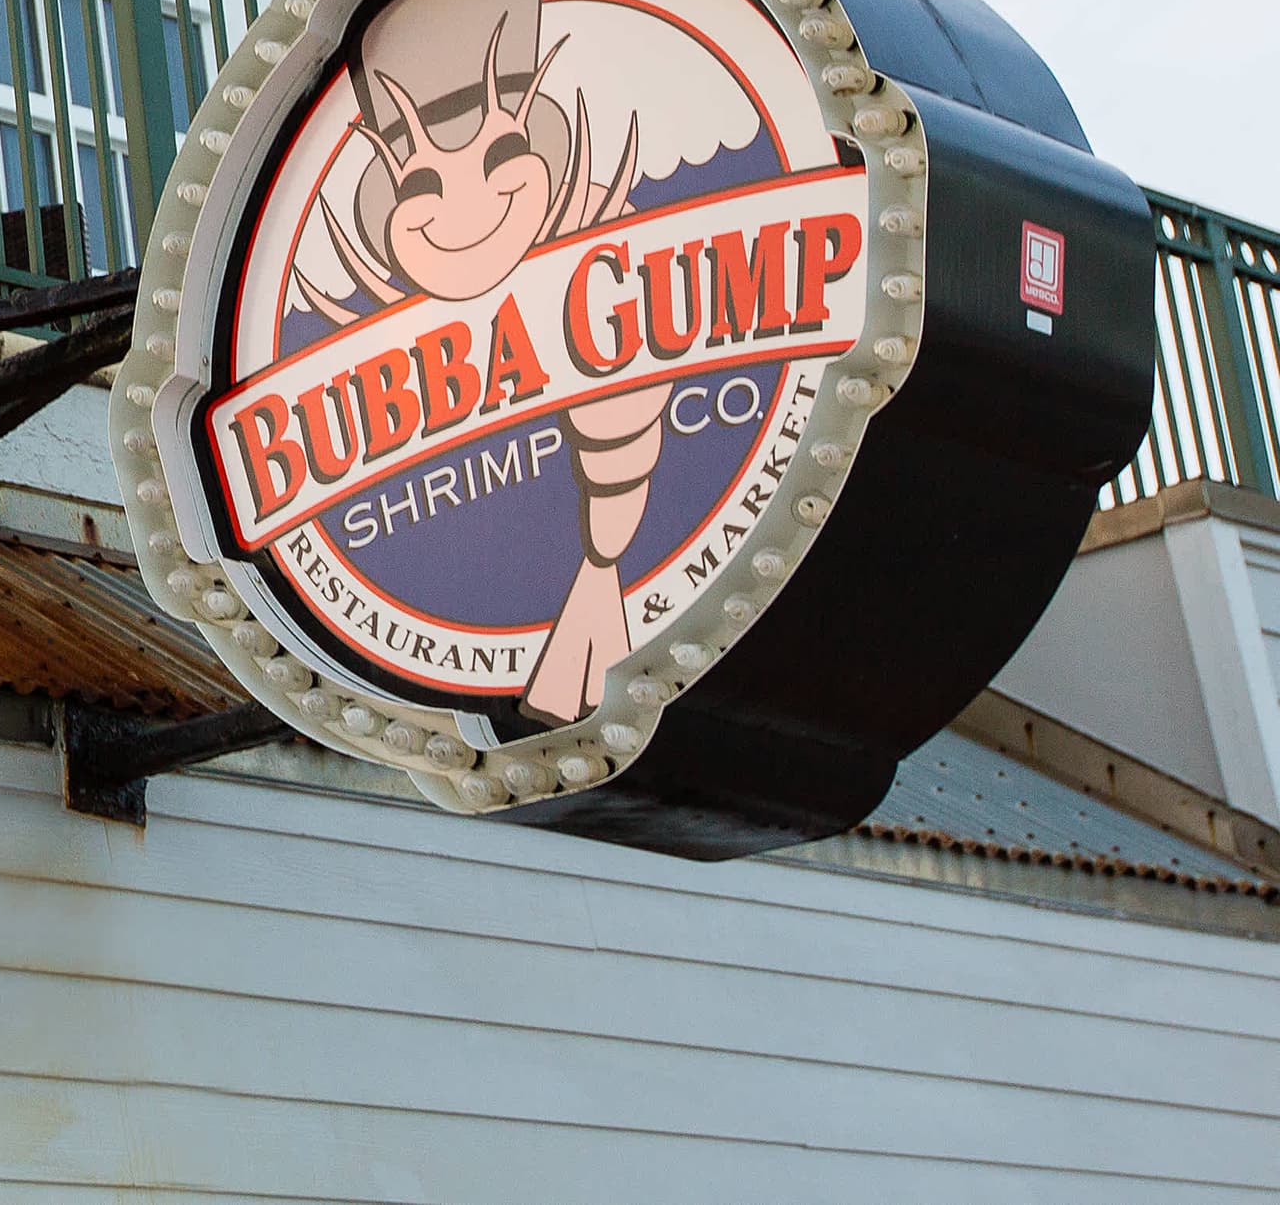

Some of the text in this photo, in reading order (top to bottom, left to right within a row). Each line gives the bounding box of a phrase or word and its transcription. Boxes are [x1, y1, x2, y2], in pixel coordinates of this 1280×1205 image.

[228, 211, 863, 526] BUBBA GUMP
[340, 376, 765, 549] SHRIMP CO.
[287, 373, 818, 674] RESTAURANT & MARKET
